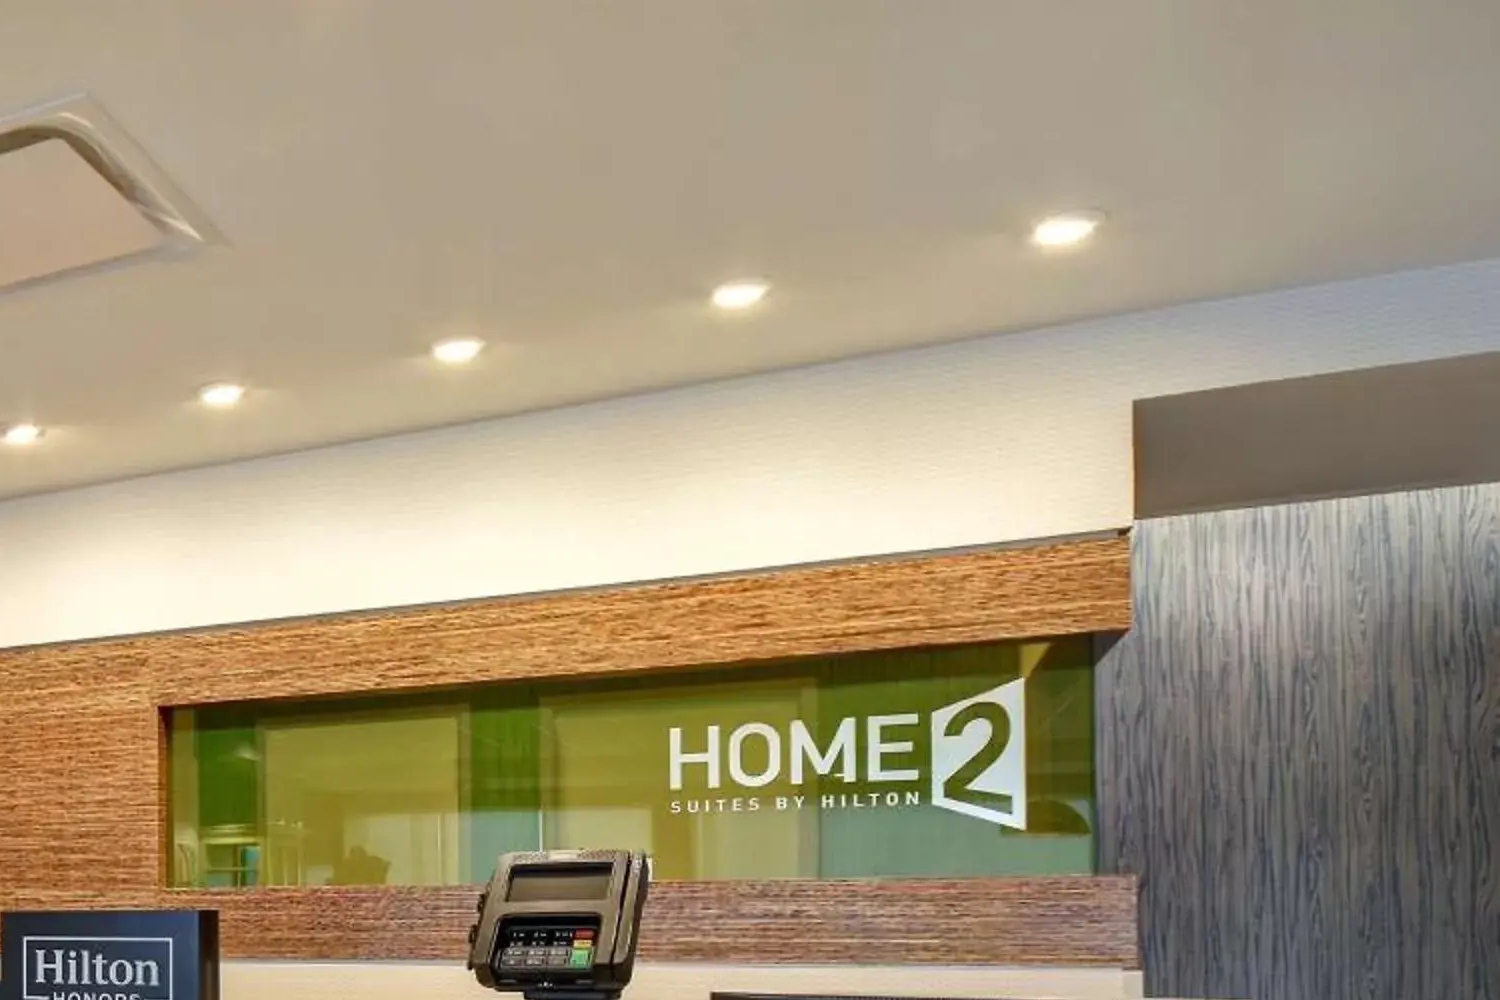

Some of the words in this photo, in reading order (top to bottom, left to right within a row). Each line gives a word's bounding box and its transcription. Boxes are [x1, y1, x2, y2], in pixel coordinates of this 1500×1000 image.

[669, 797, 761, 814] SUITES
[775, 796, 805, 811] BY
[820, 791, 921, 809] HILTON
[34, 949, 160, 987] Hilton
